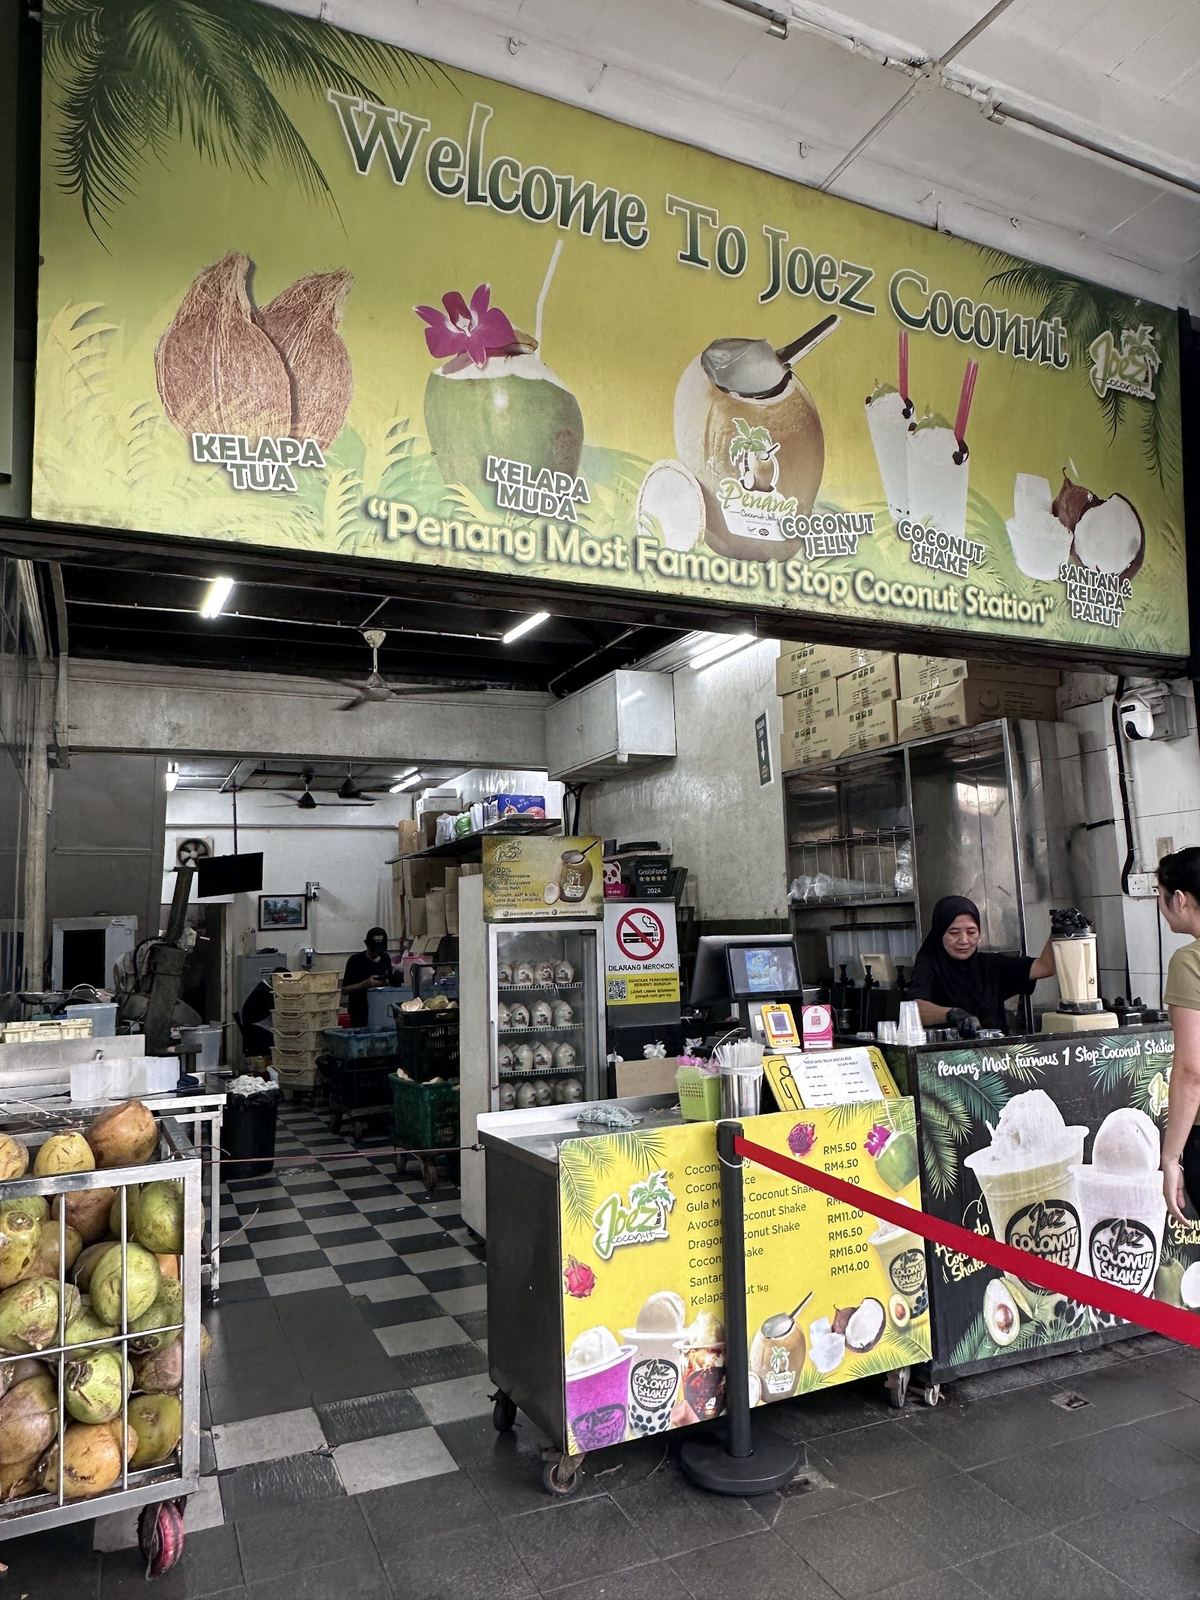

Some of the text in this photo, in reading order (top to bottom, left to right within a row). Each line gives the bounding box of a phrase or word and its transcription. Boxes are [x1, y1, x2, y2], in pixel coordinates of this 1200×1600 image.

[327, 88, 1069, 369] Welcome To Joez Coconut
[1090, 331, 1147, 398] Joez
[192, 433, 326, 467] KELAPA
[227, 462, 298, 492] TUA
[486, 455, 590, 504] KELAPA
[497, 480, 578, 522] MUDA
[717, 478, 798, 516] Penang
[780, 512, 876, 539] COCONUT
[804, 534, 858, 559] JELLY
[898, 518, 985, 564] COCONUT
[546, 525, 628, 569] Most
[637, 536, 760, 588] Famous
[766, 560, 779, 590] 1
[786, 560, 849, 605] Stop
[855, 569, 960, 613] Coconut
[911, 543, 970, 578] SHAKE
[1060, 564, 1132, 599] SANTAN &
[1068, 578, 1126, 612] KELAPA
[1072, 600, 1122, 628] PARUT
[608, 964, 641, 972] DILARANG
[938, 1061, 980, 1080] Penang
[982, 1055, 1010, 1073] Most
[1063, 1049, 1070, 1066] 1
[1075, 1046, 1100, 1063] Stop
[1102, 1041, 1142, 1060] Coconut
[1144, 1037, 1174, 1055] Statio
[1148, 1072, 1169, 1116] Jo
[823, 1141, 857, 1155] RM5.50
[824, 1159, 859, 1172] RM4.50
[687, 1200, 709, 1213] Gula
[749, 1187, 789, 1202] Coconut
[791, 1183, 817, 1195] Shak
[593, 1193, 657, 1259] Joez
[687, 1203, 807, 1232] Avoca oconut Shake
[744, 1226, 770, 1240] conut
[772, 1222, 801, 1235] Shake
[827, 1210, 864, 1224] RM11.00
[1029, 1202, 1066, 1240] Joez
[606, 1230, 661, 1244] coconut
[829, 1227, 863, 1241] RM6.50
[1011, 1228, 1078, 1252] COCONUT
[1110, 1219, 1145, 1254] Joez
[689, 1246, 764, 1268] Cocon ake
[830, 1243, 868, 1259] RM16.00
[1093, 1240, 1153, 1270] COCONUT
[830, 1261, 870, 1277] RM14.00
[1101, 1261, 1144, 1285] SHAKE
[691, 1291, 725, 1306] Kelapa
[634, 1373, 676, 1389] COCONUT
[638, 1385, 668, 1400] SHAKE
